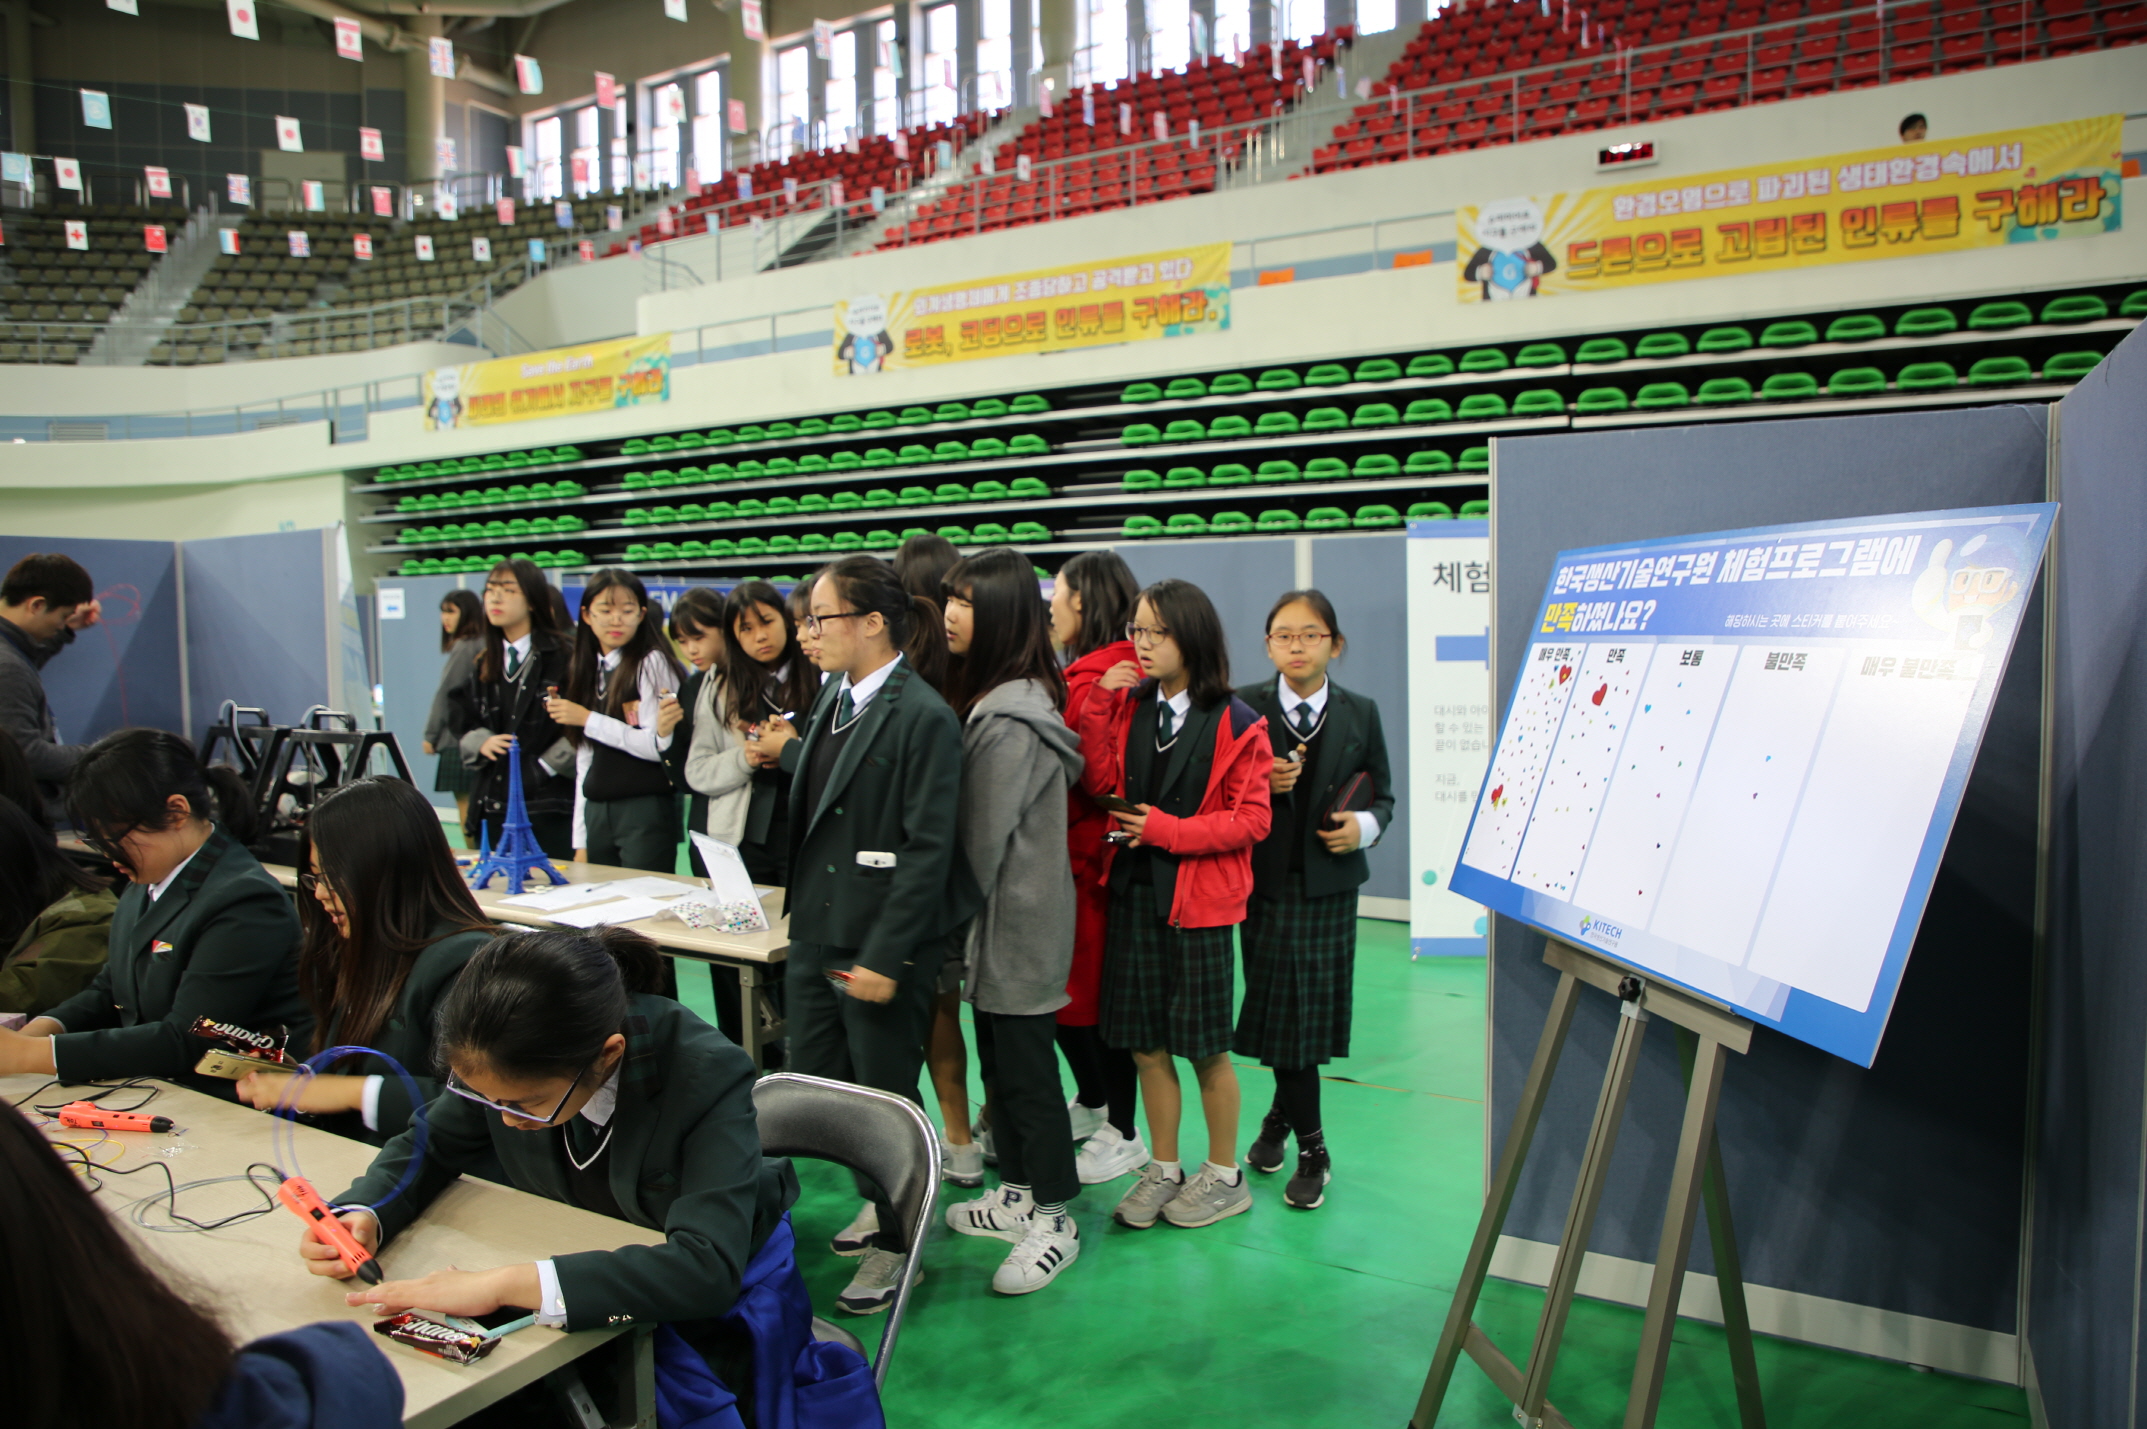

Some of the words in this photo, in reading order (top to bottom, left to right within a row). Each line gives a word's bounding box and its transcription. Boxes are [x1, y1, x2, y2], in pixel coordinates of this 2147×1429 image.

[1613, 180, 1751, 222] 환경오염으로
[1757, 168, 1830, 203] 파괴된
[1838, 142, 2022, 191] 생태환경속에서
[1566, 226, 1705, 280] 드론으로
[1715, 211, 1827, 263] 고립된
[1840, 195, 1960, 249] 인류를
[1973, 175, 2107, 232] 구해라
[1092, 262, 1155, 291] 공격받고
[1159, 257, 1194, 282] 있다
[904, 325, 953, 359] 로봇,
[959, 311, 1047, 350] 코딩으로
[1055, 300, 1125, 340] 인류를
[1132, 290, 1217, 330] 구해라.
[521, 363, 545, 378] Save
[547, 359, 563, 373] the
[565, 355, 594, 371] Earth
[570, 376, 613, 407] 지구를
[1433, 561, 1490, 593] 체험
[1553, 551, 1719, 595] 한국생산기술연구원
[1716, 535, 1922, 583] 체험프로그램에
[1540, 600, 1657, 633] 만족하셨나요?
[1725, 614, 1769, 628] 해당하시는
[1770, 614, 1790, 628] 곳에
[1791, 614, 1834, 628] 스티커를
[1538, 648, 1554, 661] 매우
[1554, 647, 1572, 661] 만족
[1606, 648, 1627, 663] 만족
[1679, 649, 1704, 666] 보통
[1764, 652, 1808, 671] 불만족
[1860, 656, 1897, 677] 매우
[1899, 657, 1958, 680] 불만족
[1448, 723, 1459, 734] 수
[1462, 722, 1484, 734] 있는
[1592, 919, 1623, 940] KITECH
[212, 1023, 275, 1049] Ghana
[1002, 1189, 1022, 1209] P
